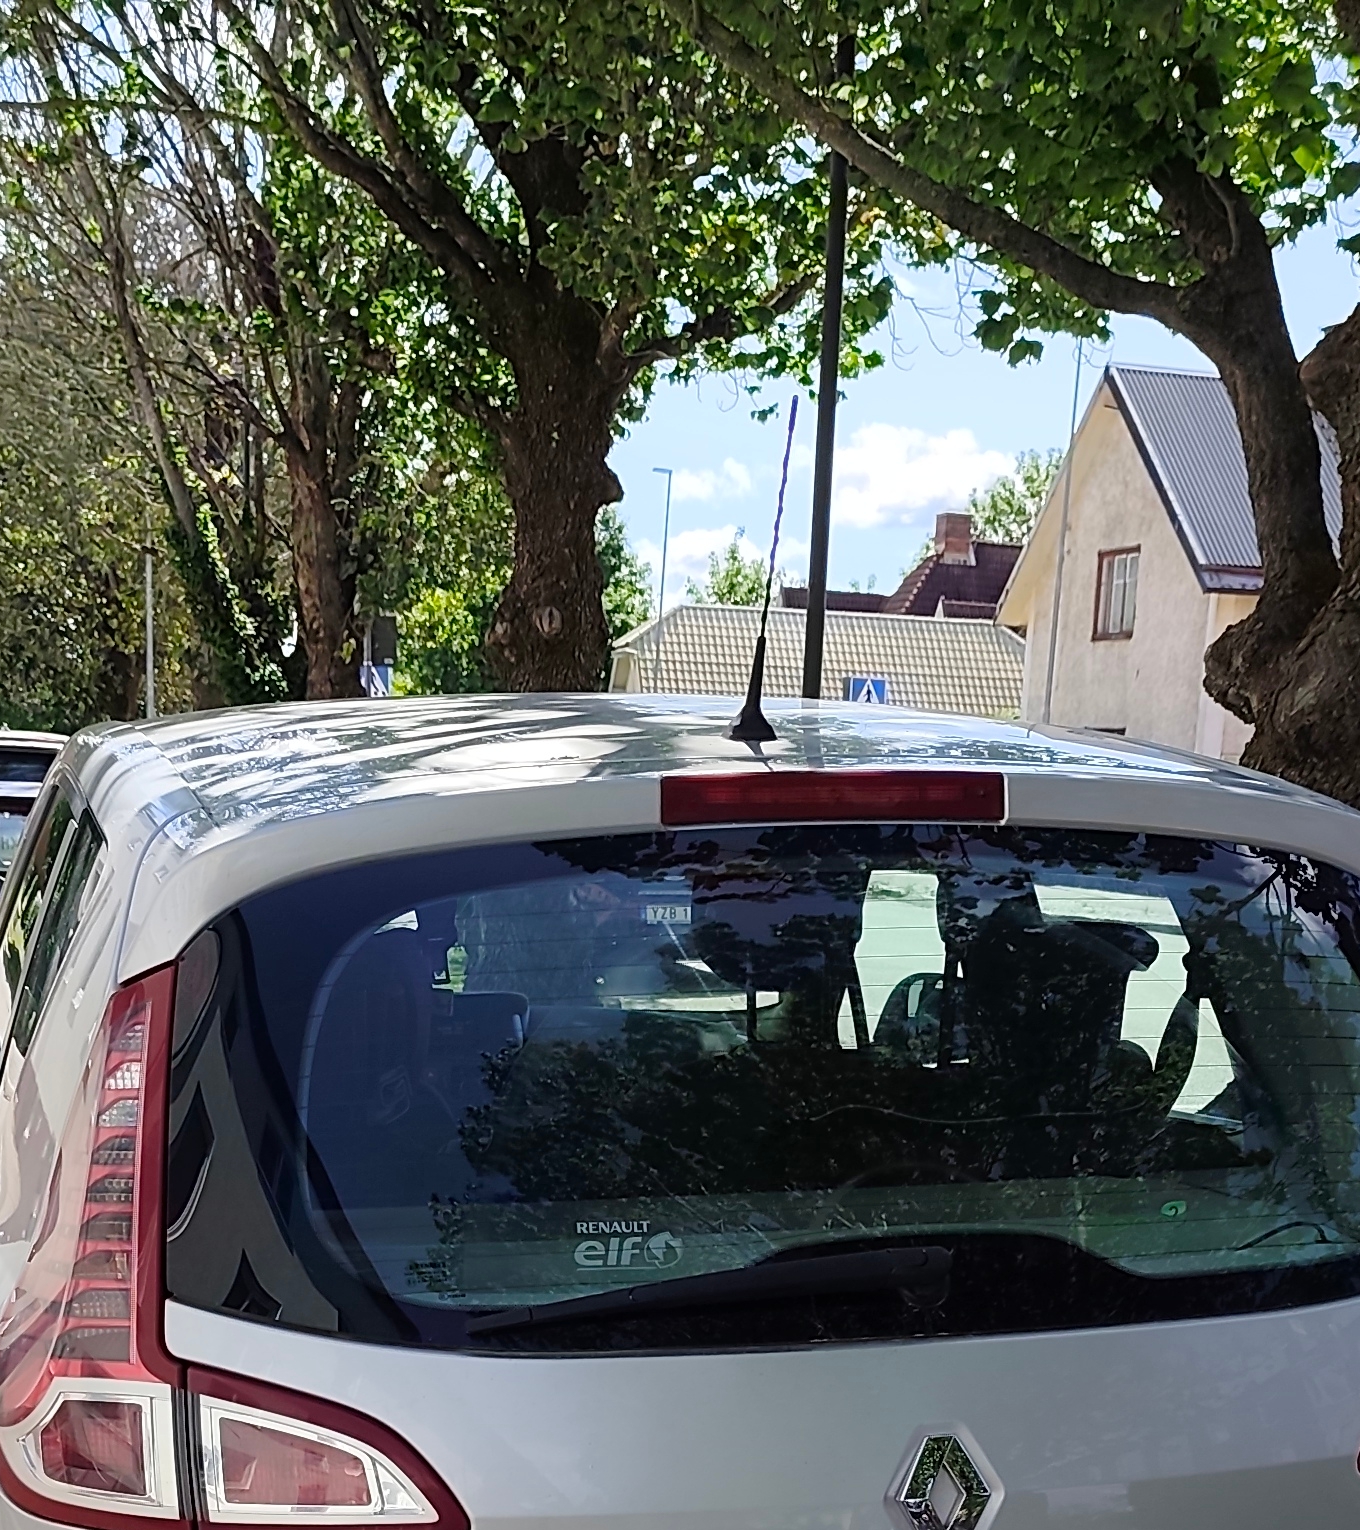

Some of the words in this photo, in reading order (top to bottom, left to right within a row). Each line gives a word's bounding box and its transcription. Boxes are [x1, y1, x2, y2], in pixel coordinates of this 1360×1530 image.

[652, 906, 677, 920] YZB
[576, 1220, 650, 1234] RENAULT
[573, 1236, 643, 1267] elf
